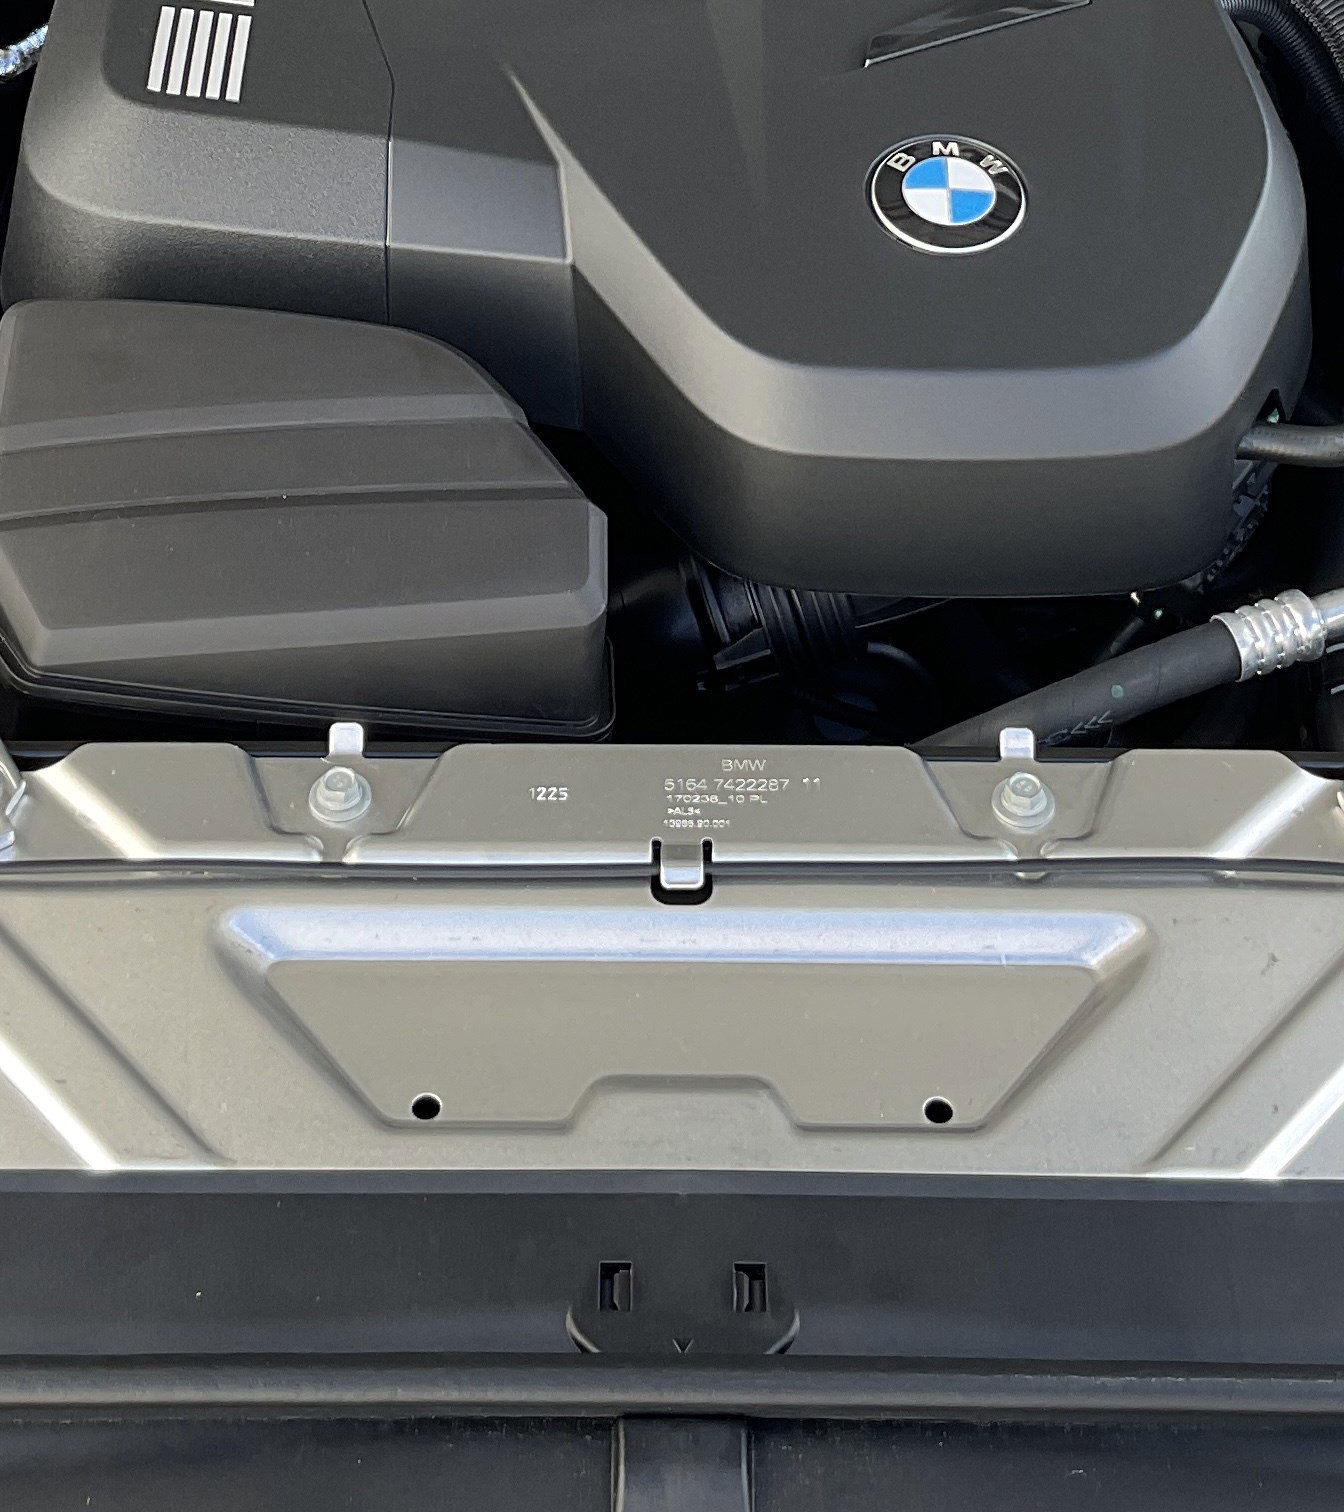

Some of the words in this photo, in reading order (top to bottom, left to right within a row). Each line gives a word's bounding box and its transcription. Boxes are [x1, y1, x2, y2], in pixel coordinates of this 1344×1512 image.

[886, 141, 1008, 175] BMW
[721, 759, 767, 773] BMW
[664, 778, 707, 792] 5164
[713, 778, 790, 792] 7422287
[529, 786, 569, 801] 1225
